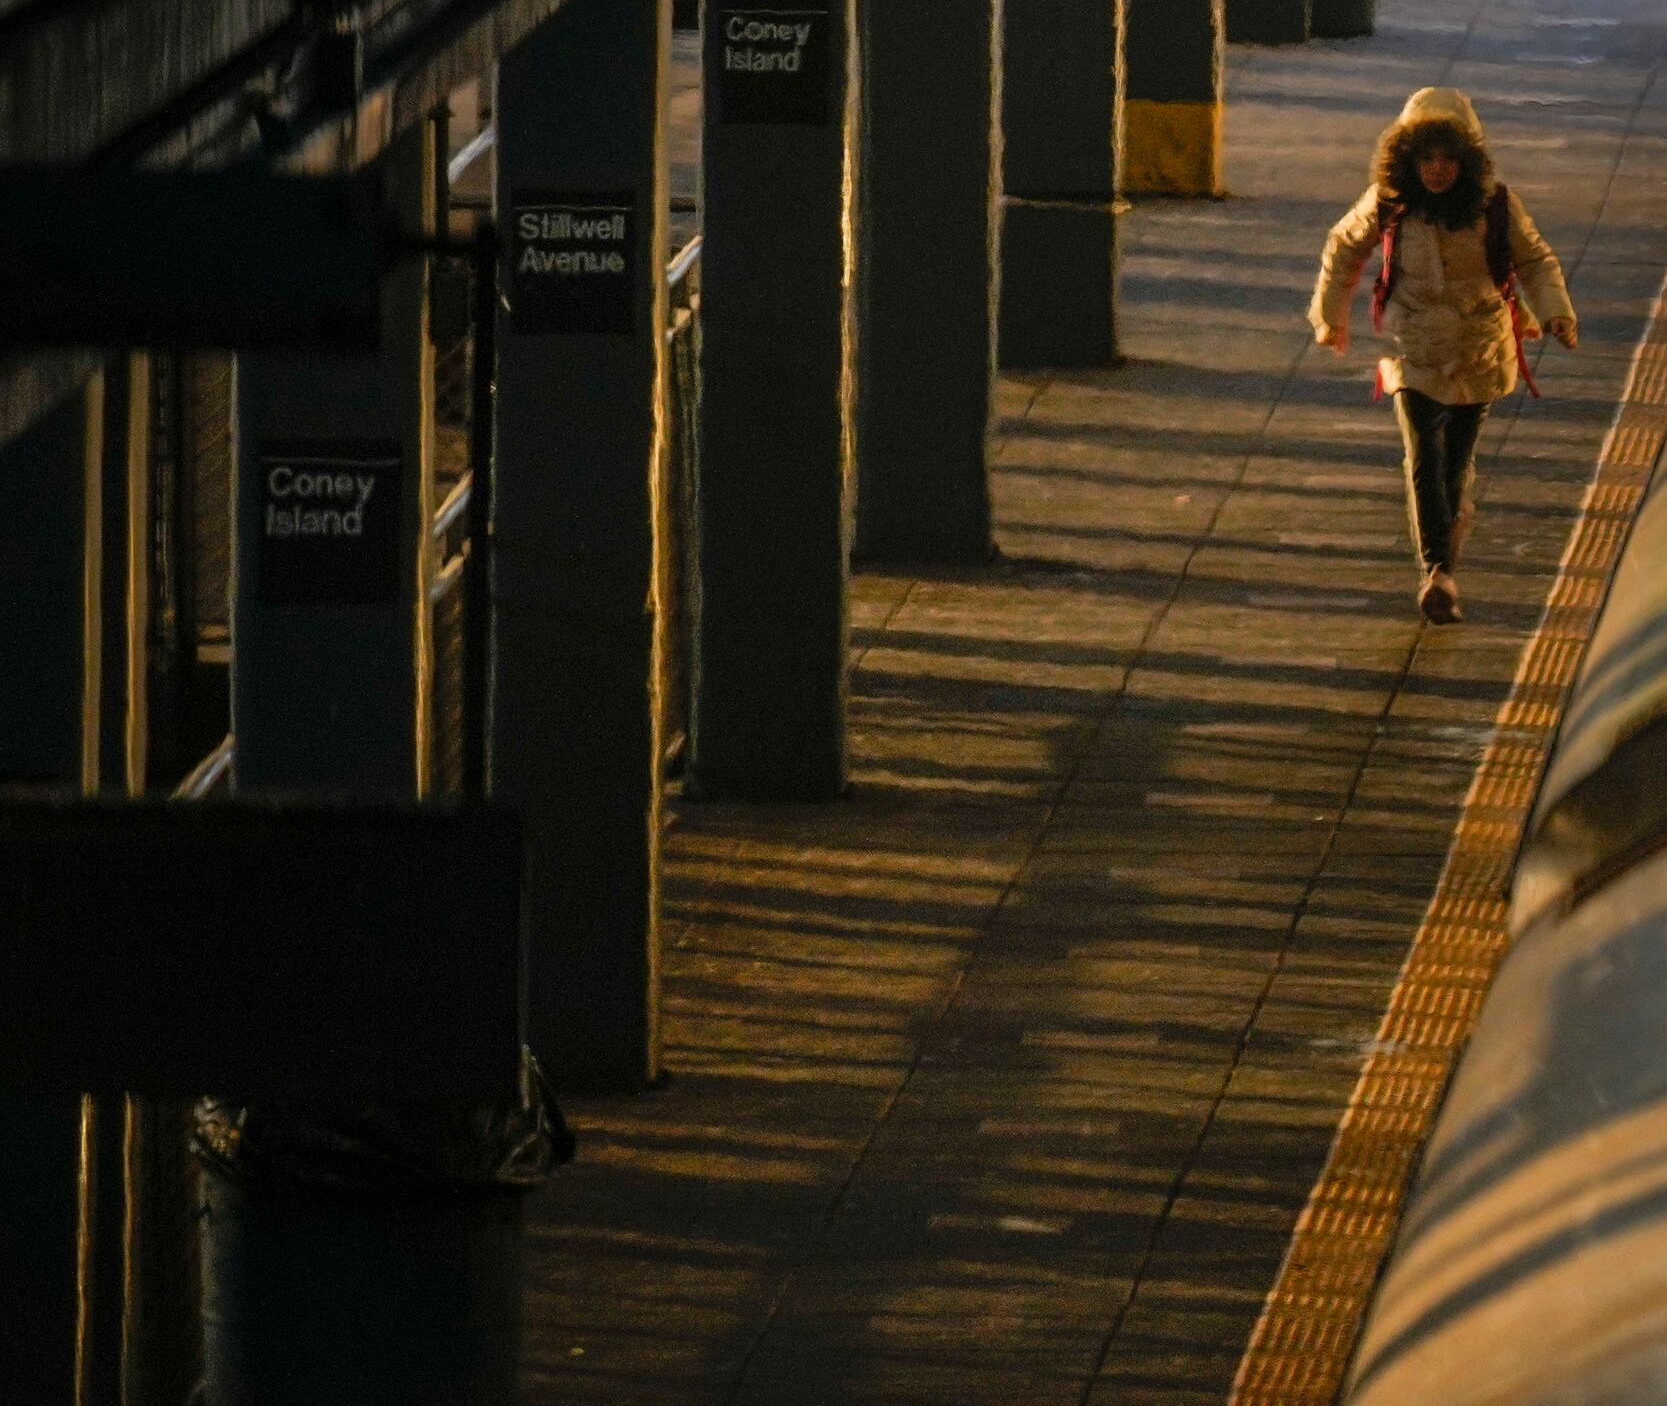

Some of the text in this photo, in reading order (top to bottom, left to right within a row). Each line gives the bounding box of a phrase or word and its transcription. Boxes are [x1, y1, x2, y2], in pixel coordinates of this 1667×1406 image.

[726, 16, 812, 47] Coney
[725, 45, 801, 72] Island
[519, 213, 625, 239] Stillwell
[519, 246, 625, 273] Avenue
[268, 466, 375, 506] Coney
[265, 502, 363, 536] Island
